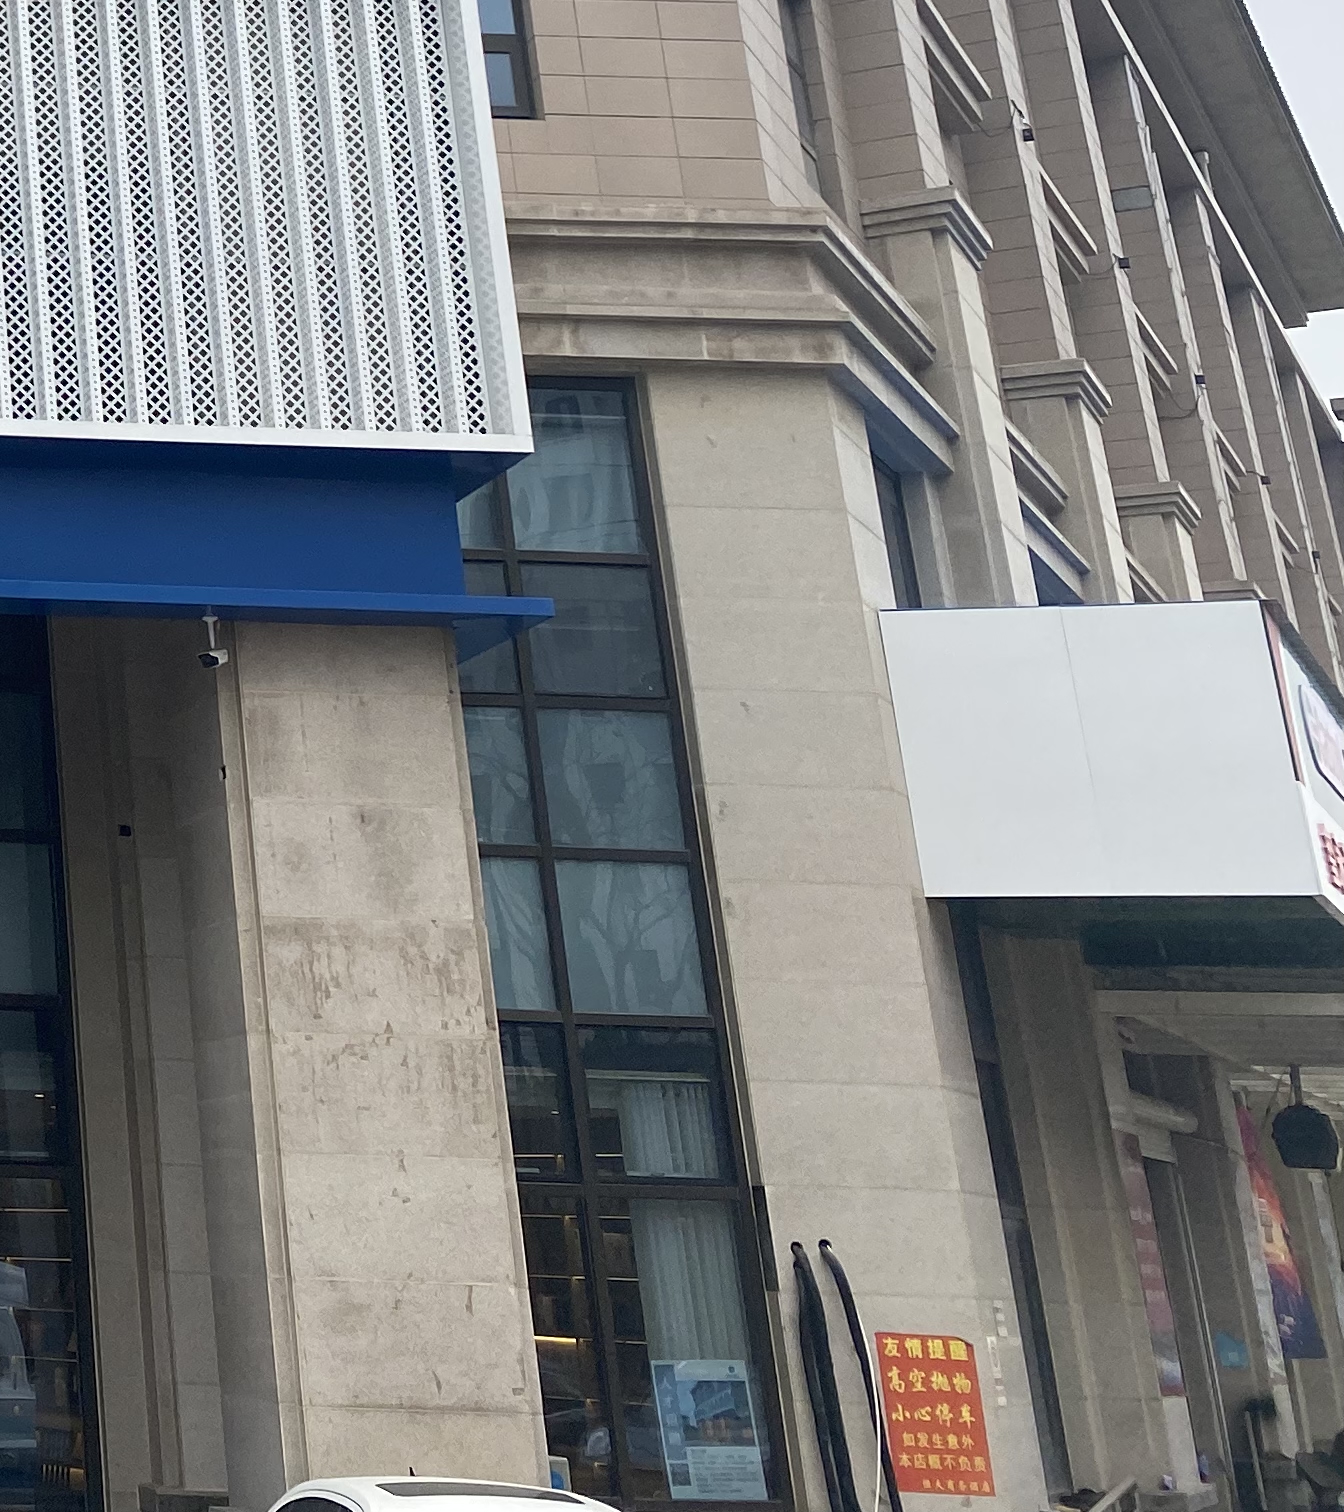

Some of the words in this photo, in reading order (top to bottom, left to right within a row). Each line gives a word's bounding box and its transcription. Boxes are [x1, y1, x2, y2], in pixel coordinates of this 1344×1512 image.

[882, 1336, 969, 1362] 友情提醒
[887, 1366, 973, 1394] 高空抛物
[891, 1402, 976, 1430] 小心停车
[902, 1430, 975, 1451] 如发生意外
[898, 1451, 988, 1473] 本店概不负责
